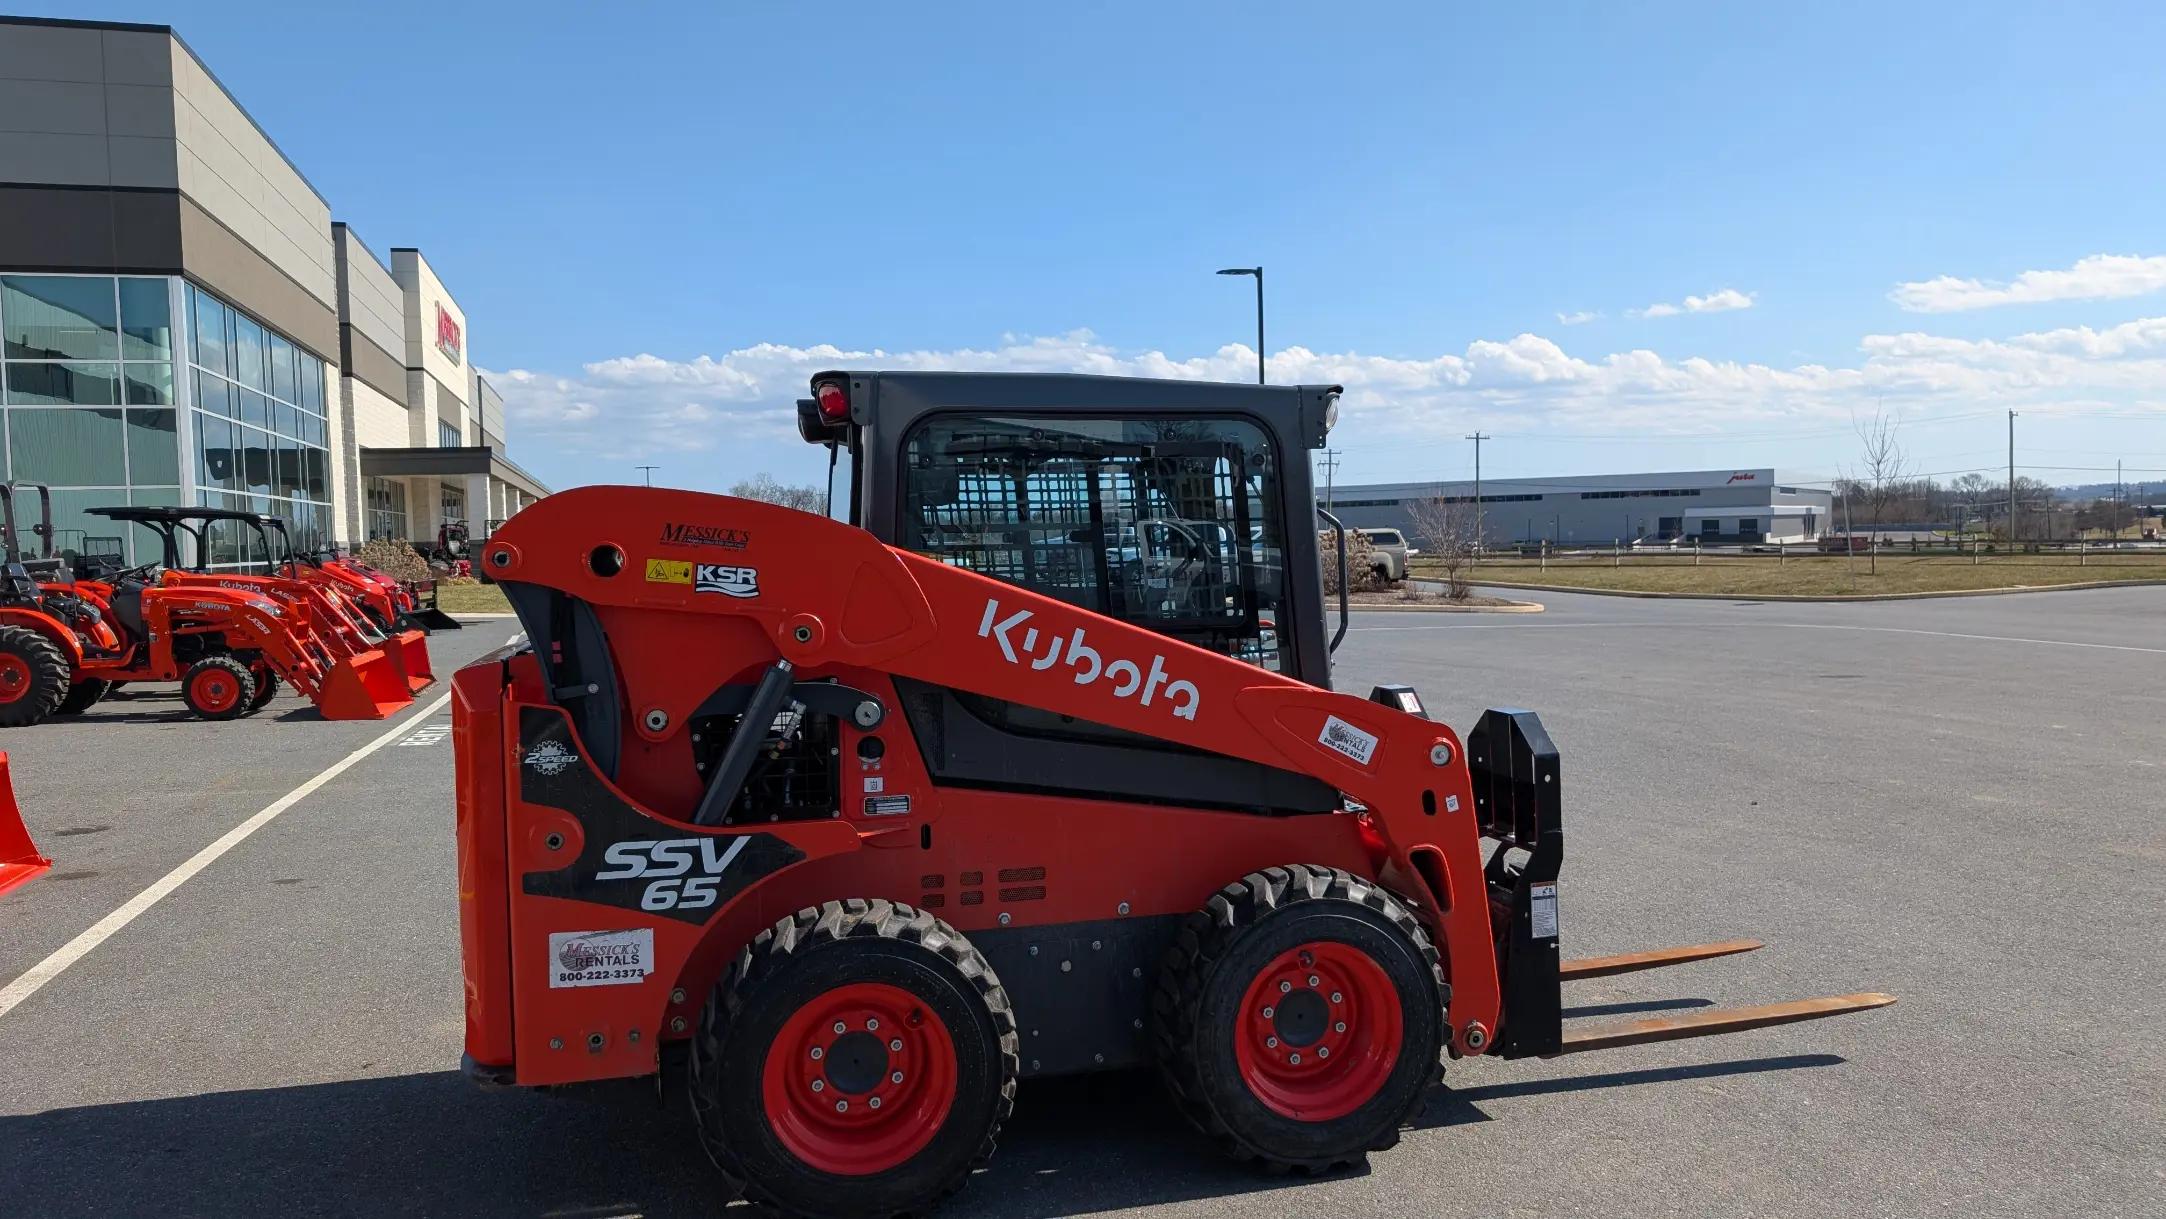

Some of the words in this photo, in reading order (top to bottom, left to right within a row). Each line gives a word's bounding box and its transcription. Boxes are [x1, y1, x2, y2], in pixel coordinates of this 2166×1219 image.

[696, 565, 757, 584] KSR
[219, 580, 262, 593] Kubota
[195, 601, 231, 612] KUBOTA
[978, 598, 1200, 721] Kubota
[595, 835, 752, 880] SSV
[640, 876, 722, 911] 65
[575, 954, 640, 968] RENTALS
[559, 968, 645, 982] 800-222-3373
